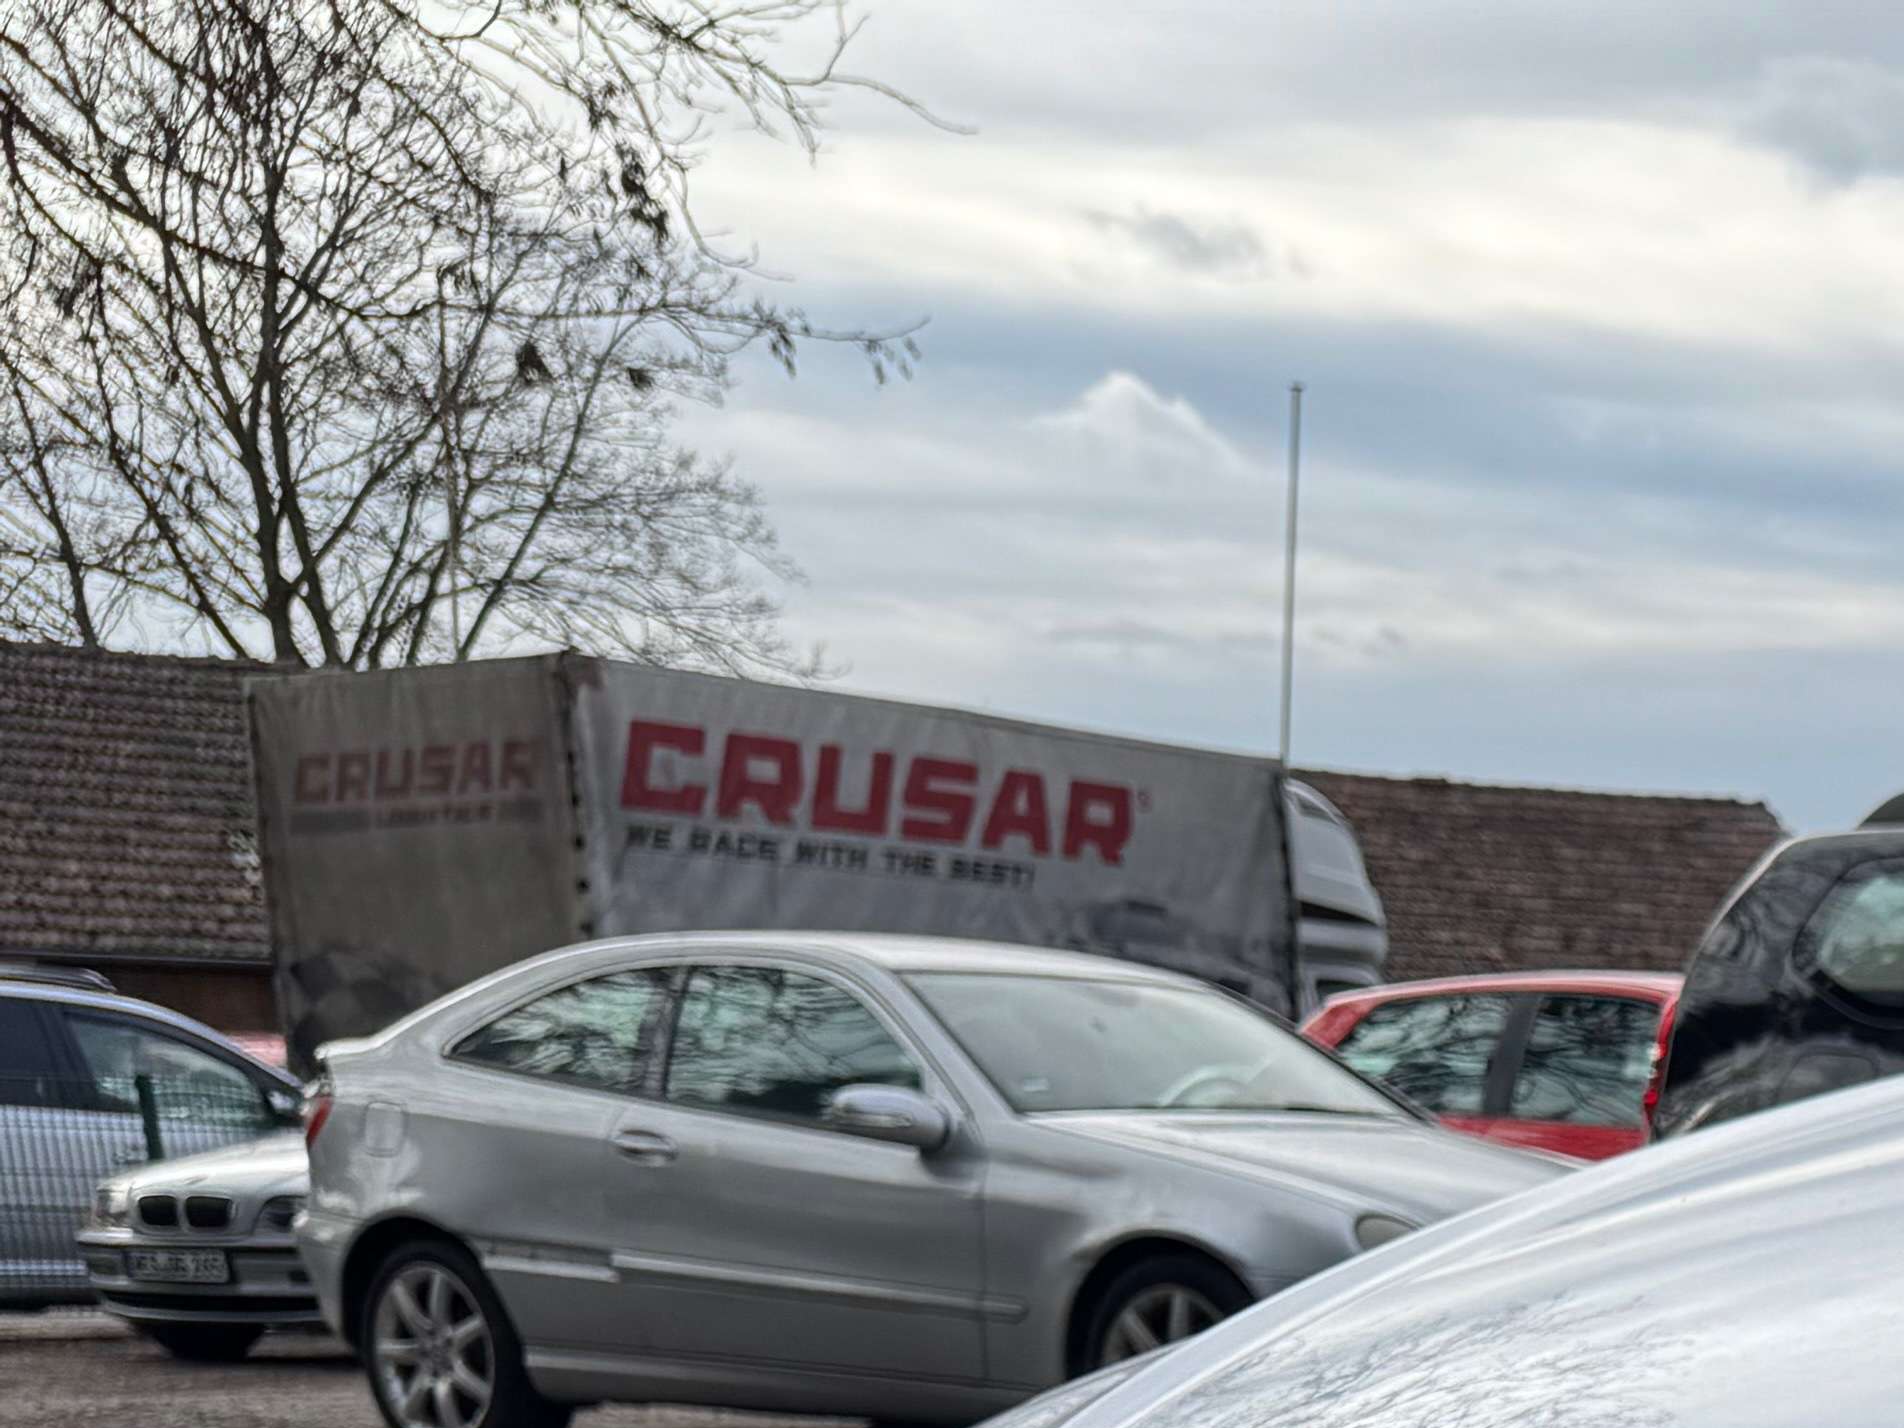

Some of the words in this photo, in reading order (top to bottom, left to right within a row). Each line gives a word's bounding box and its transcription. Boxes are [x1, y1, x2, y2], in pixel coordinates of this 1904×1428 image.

[294, 737, 545, 803] CRUSAR
[620, 719, 1135, 867] CRUSAR
[626, 822, 673, 851] WE
[796, 838, 868, 869] WITH
[882, 847, 936, 878] THE
